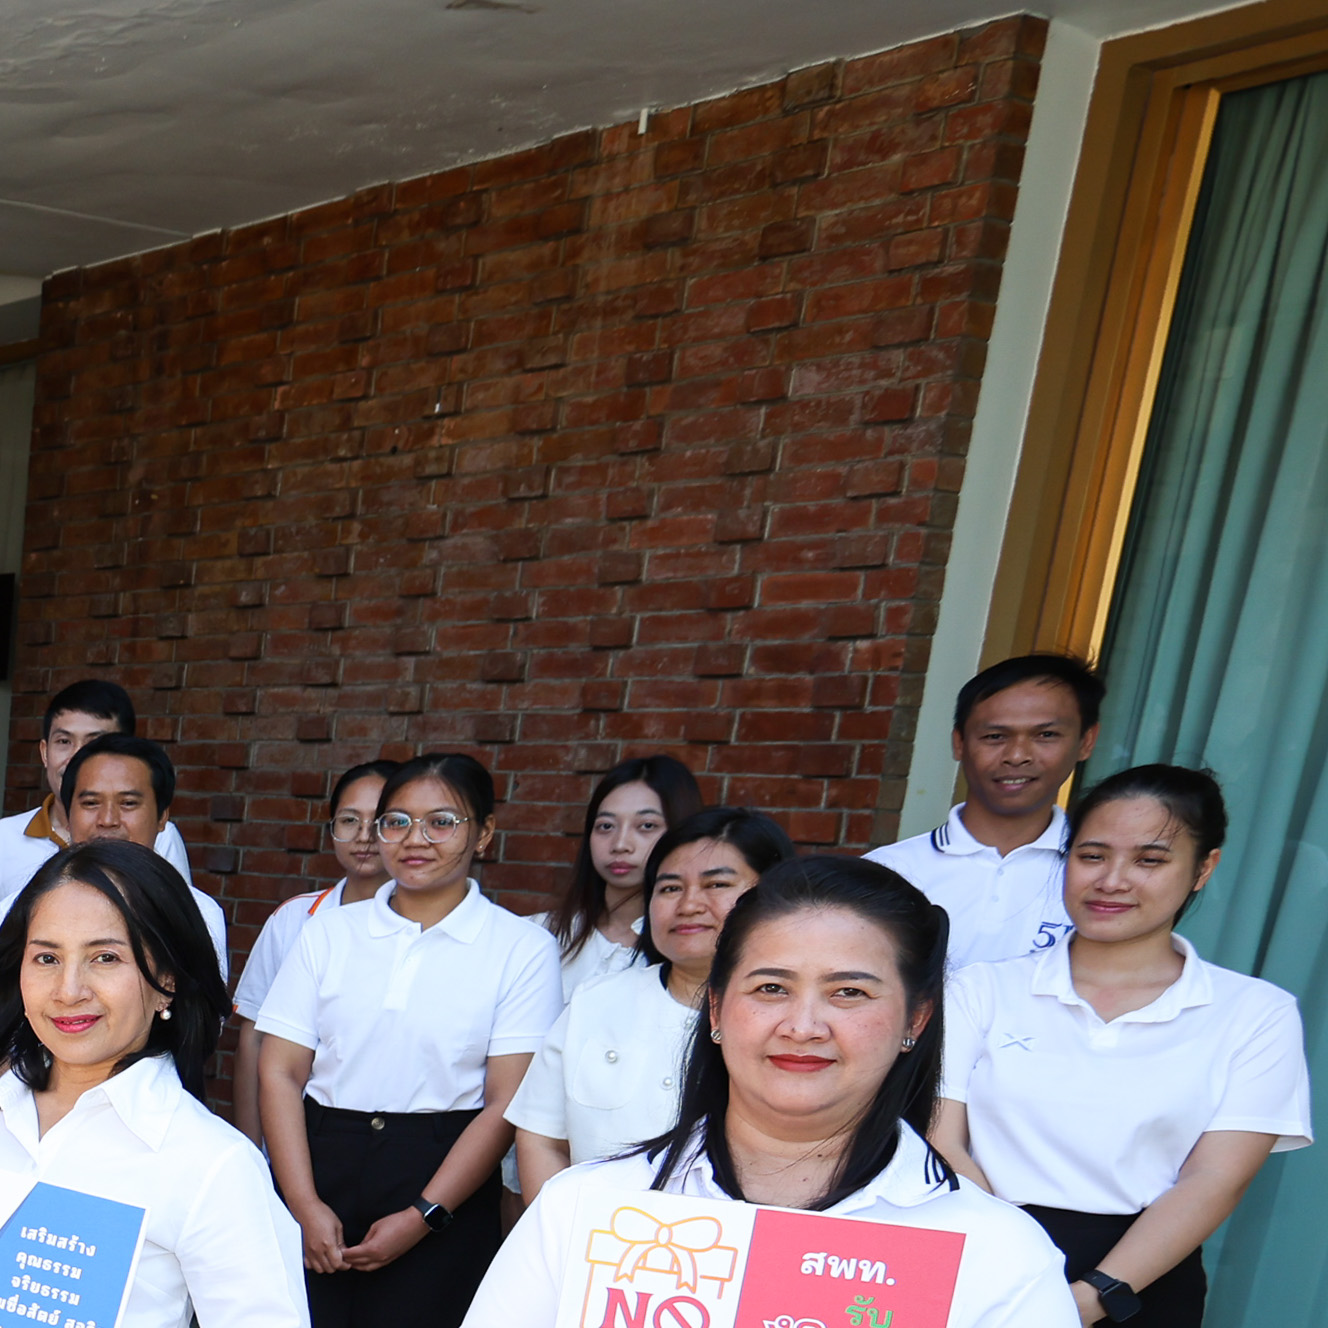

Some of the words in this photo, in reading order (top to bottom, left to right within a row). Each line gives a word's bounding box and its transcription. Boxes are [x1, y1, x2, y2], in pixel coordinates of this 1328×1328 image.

[20, 1225, 97, 1258] เสริมสร้าง
[15, 1251, 83, 1281] คุณธรรม
[800, 1251, 896, 1287] สพท.
[11, 1273, 81, 1306] จริยธรรม
